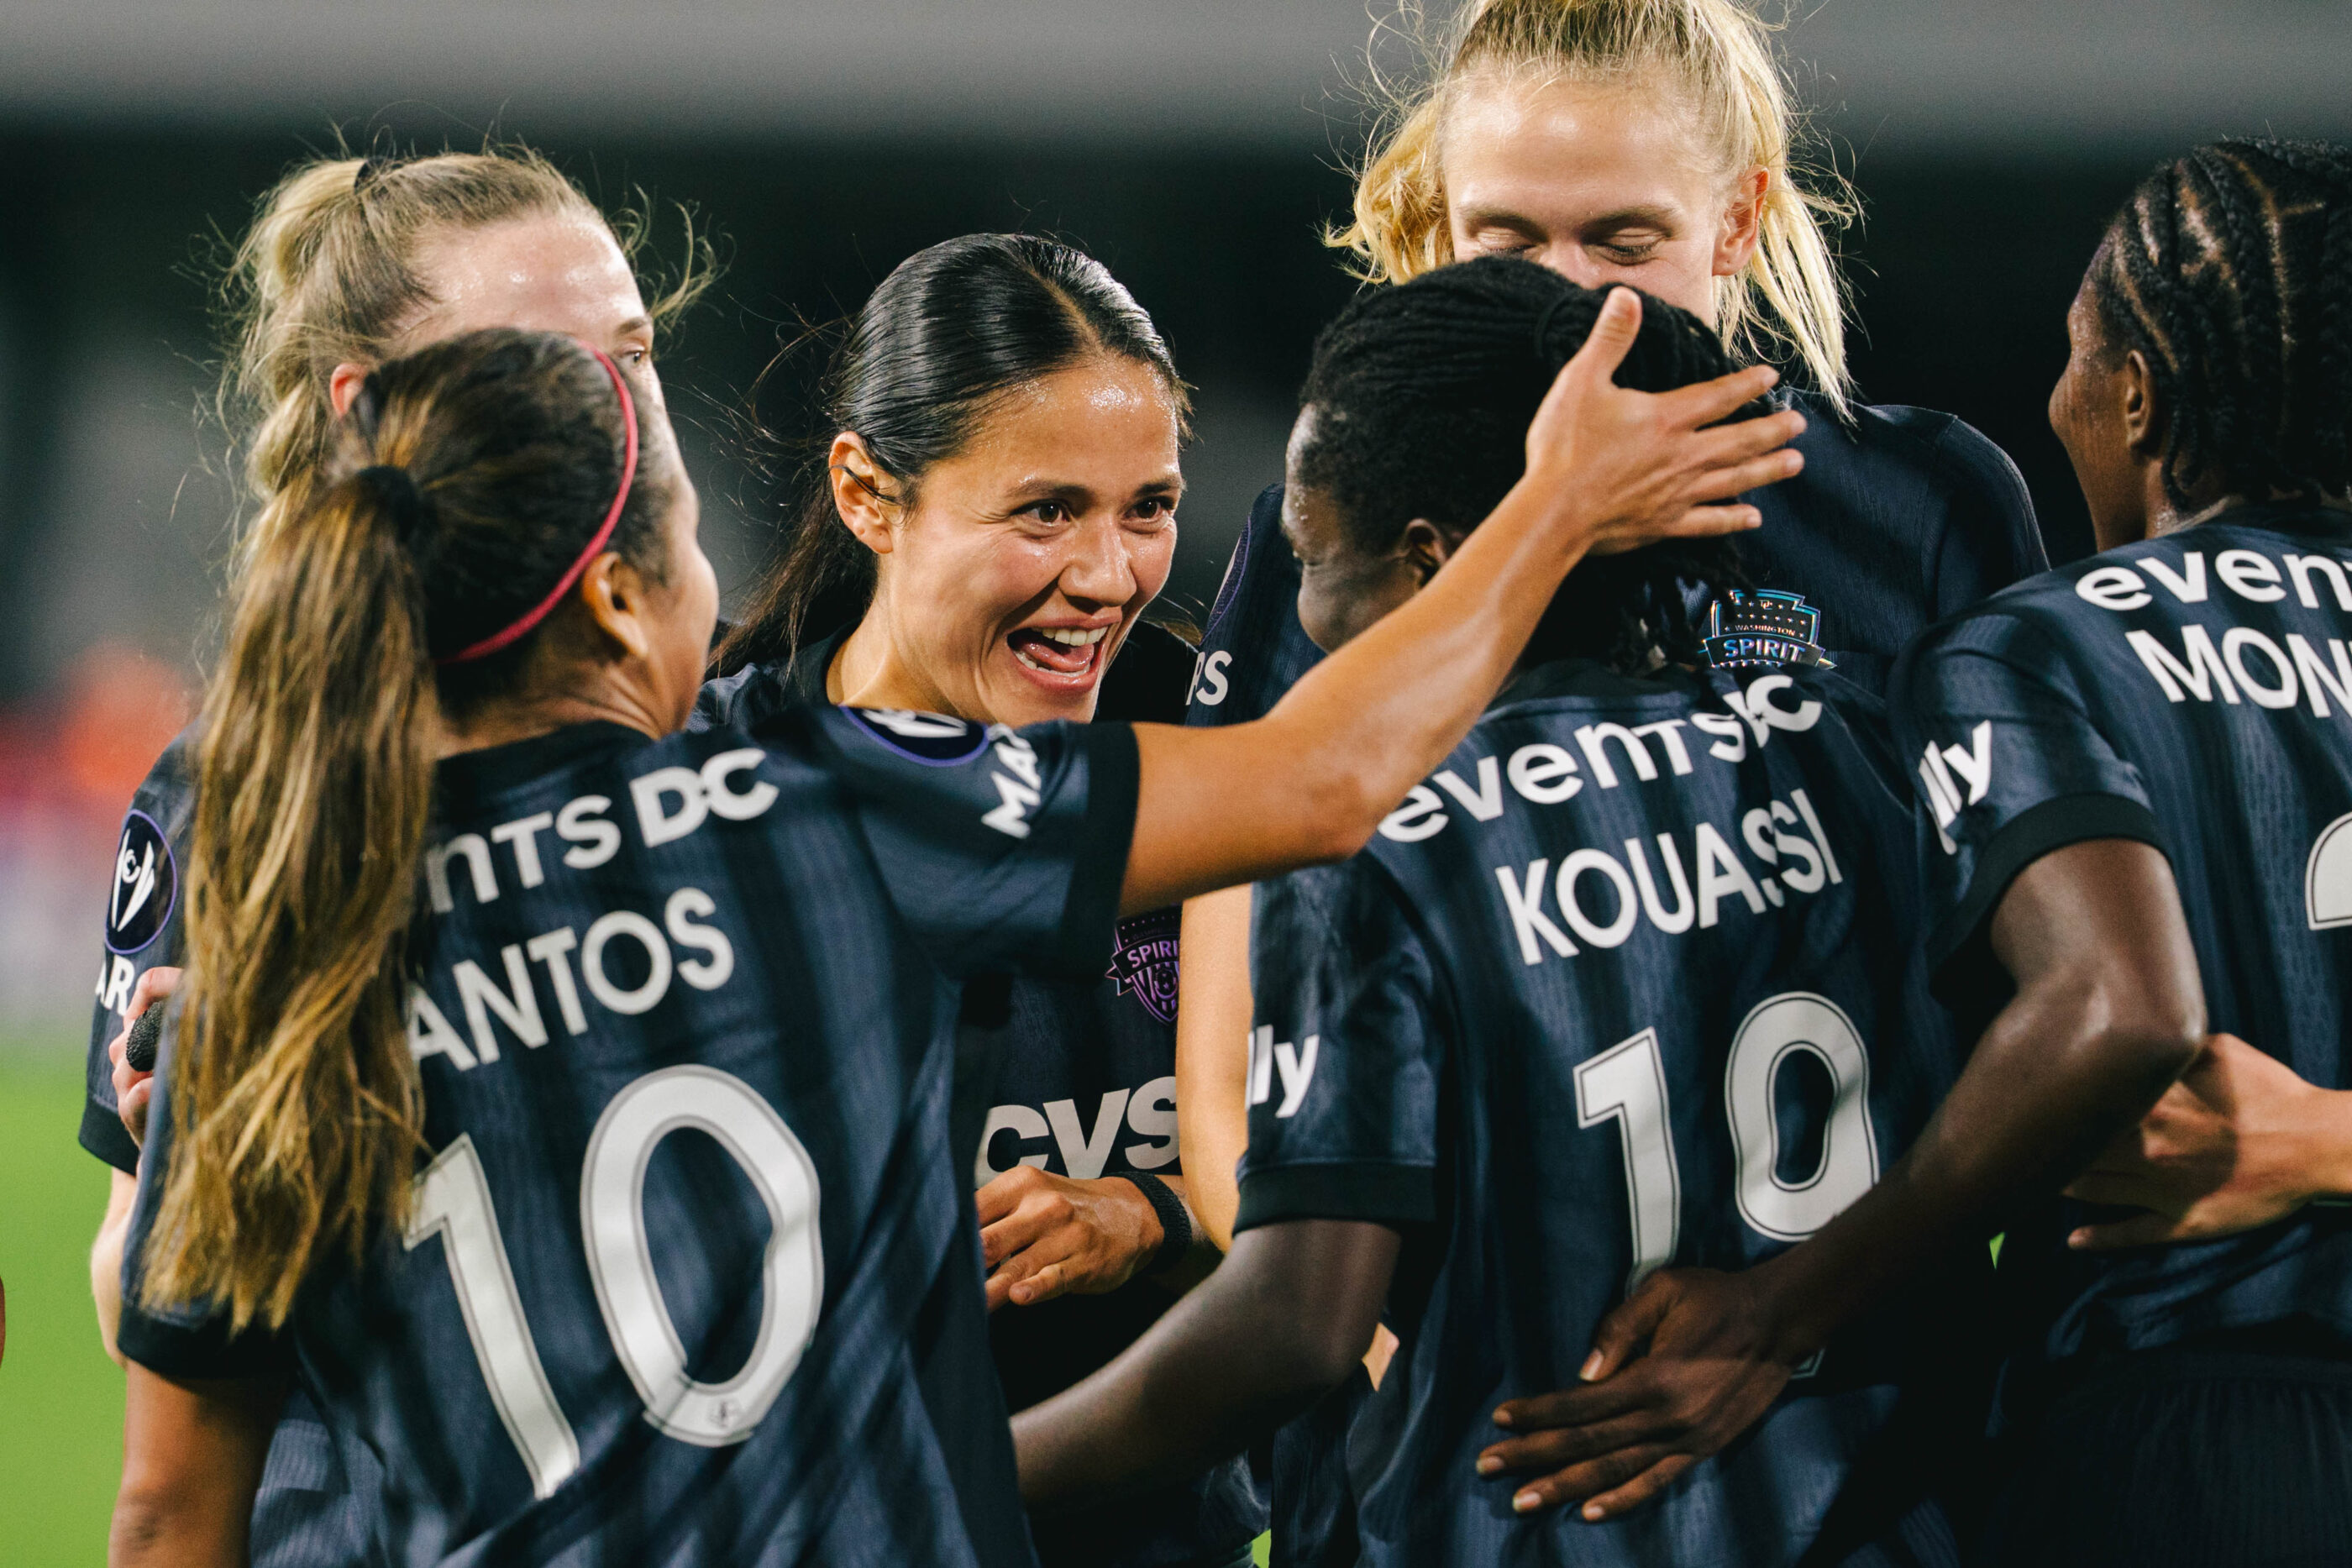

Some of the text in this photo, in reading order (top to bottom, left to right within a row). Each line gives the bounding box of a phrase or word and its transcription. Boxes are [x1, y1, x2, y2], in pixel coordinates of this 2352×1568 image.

[1735, 624, 1796, 637] WASHINGTON
[2075, 549, 2352, 612] even
[1723, 637, 1806, 663] SPIRIT
[2124, 623, 2352, 720] MON
[629, 748, 780, 849] DC
[1495, 788, 1843, 966] KOUASSI
[406, 887, 734, 1072] ANTOS
[974, 1076, 1180, 1190] CVS
[403, 1063, 825, 1501] 10
